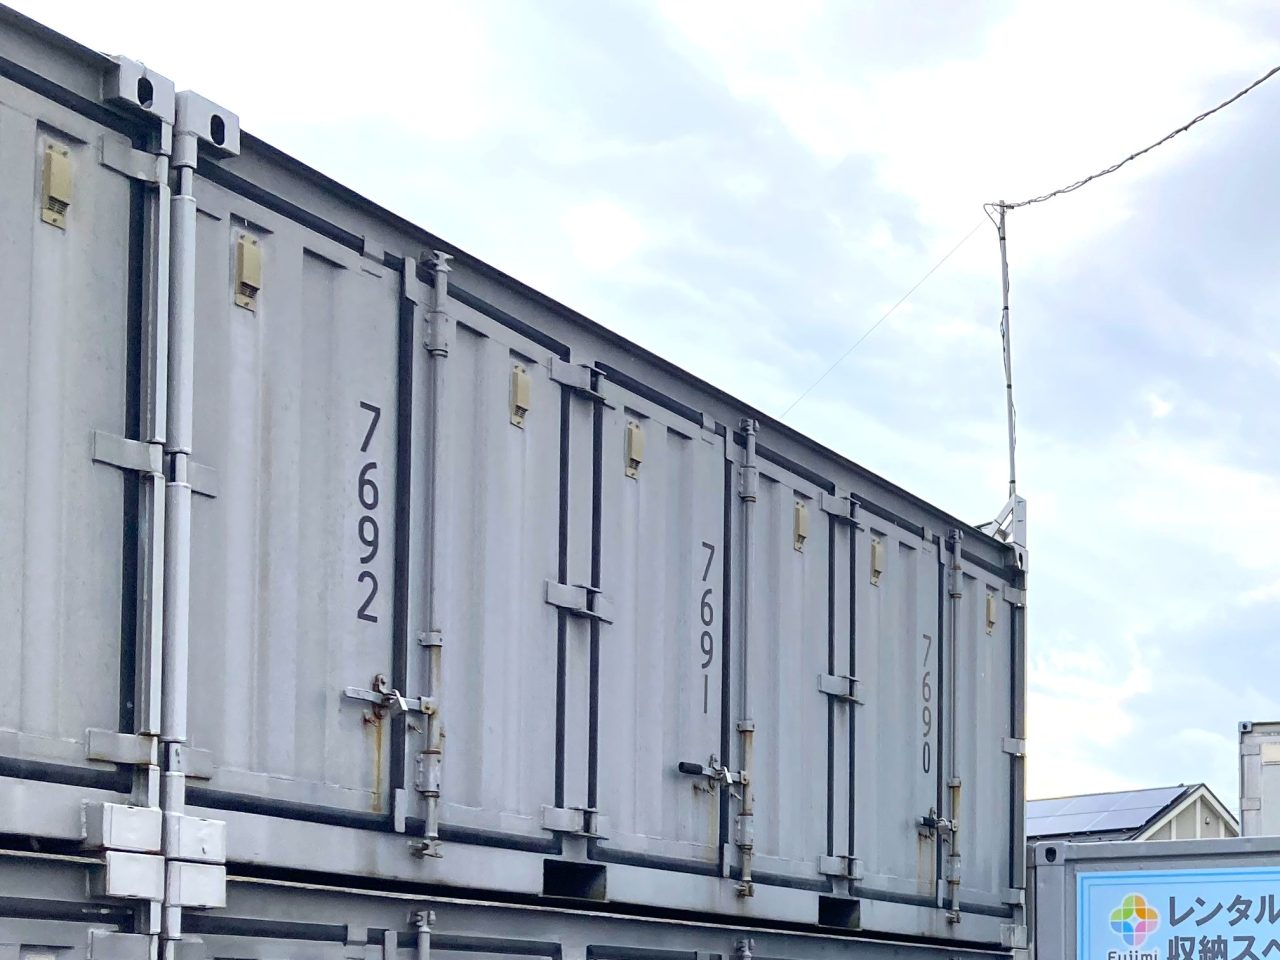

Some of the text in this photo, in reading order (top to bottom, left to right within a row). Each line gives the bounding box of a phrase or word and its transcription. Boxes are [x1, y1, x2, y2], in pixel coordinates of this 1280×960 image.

[357, 401, 381, 624] 7692
[700, 541, 715, 714] 7691
[922, 634, 932, 774] 7690
